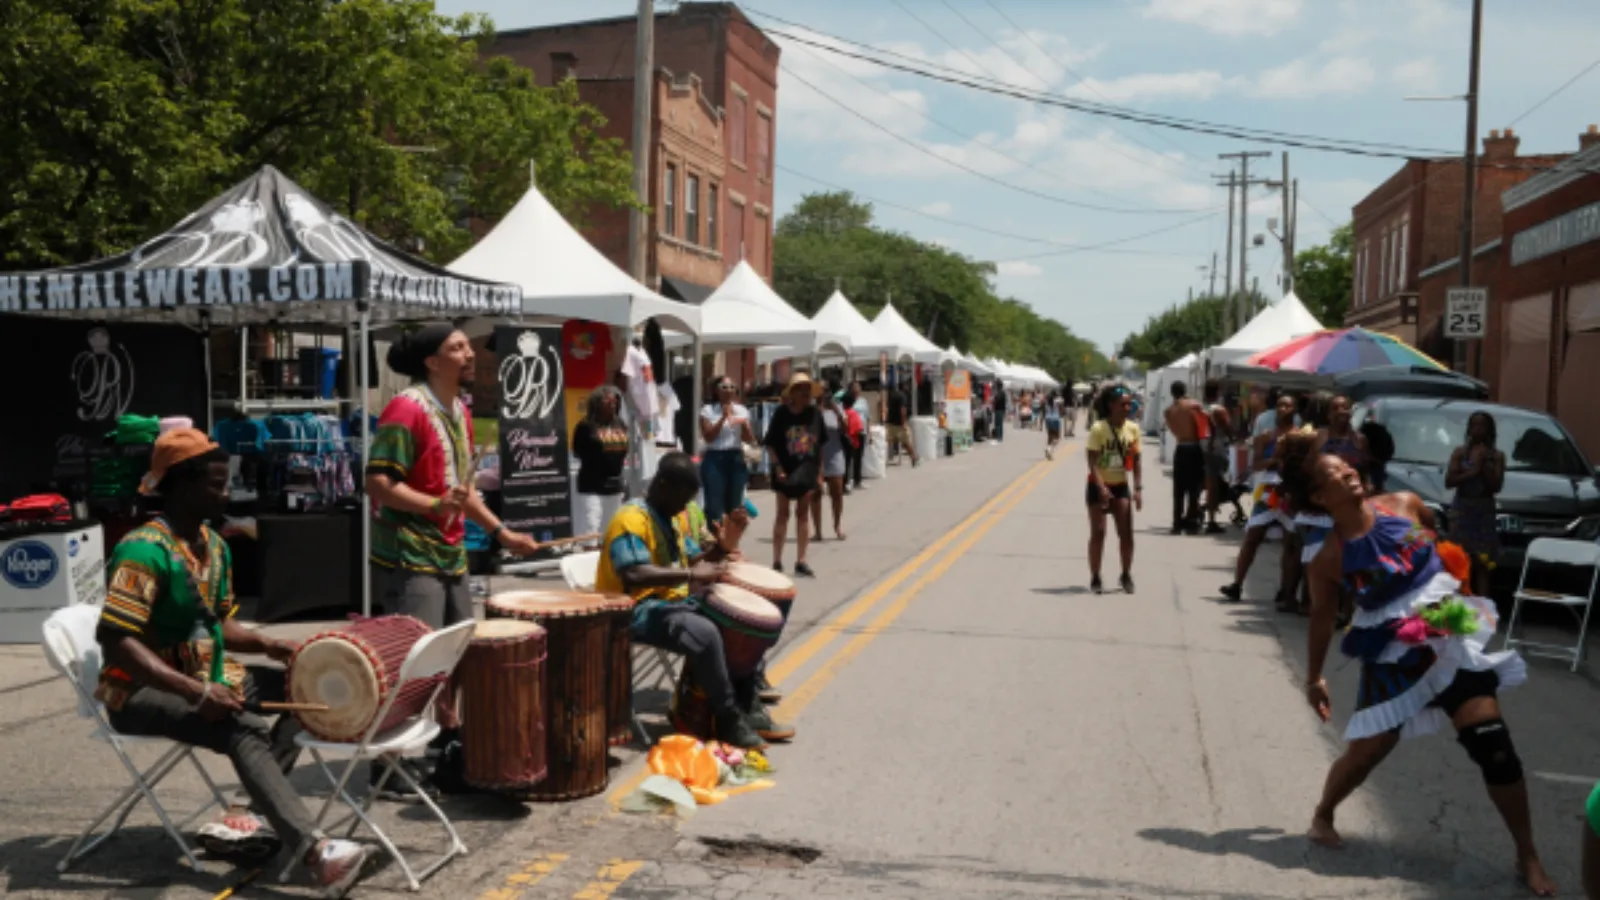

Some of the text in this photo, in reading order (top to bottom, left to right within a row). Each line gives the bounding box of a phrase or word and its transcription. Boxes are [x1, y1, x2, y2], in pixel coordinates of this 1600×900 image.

[1450, 292, 1483, 302] SPEED
[1453, 303, 1480, 312] LIMIT
[1450, 313, 1481, 333] 25
[7, 548, 52, 581] Kroger
